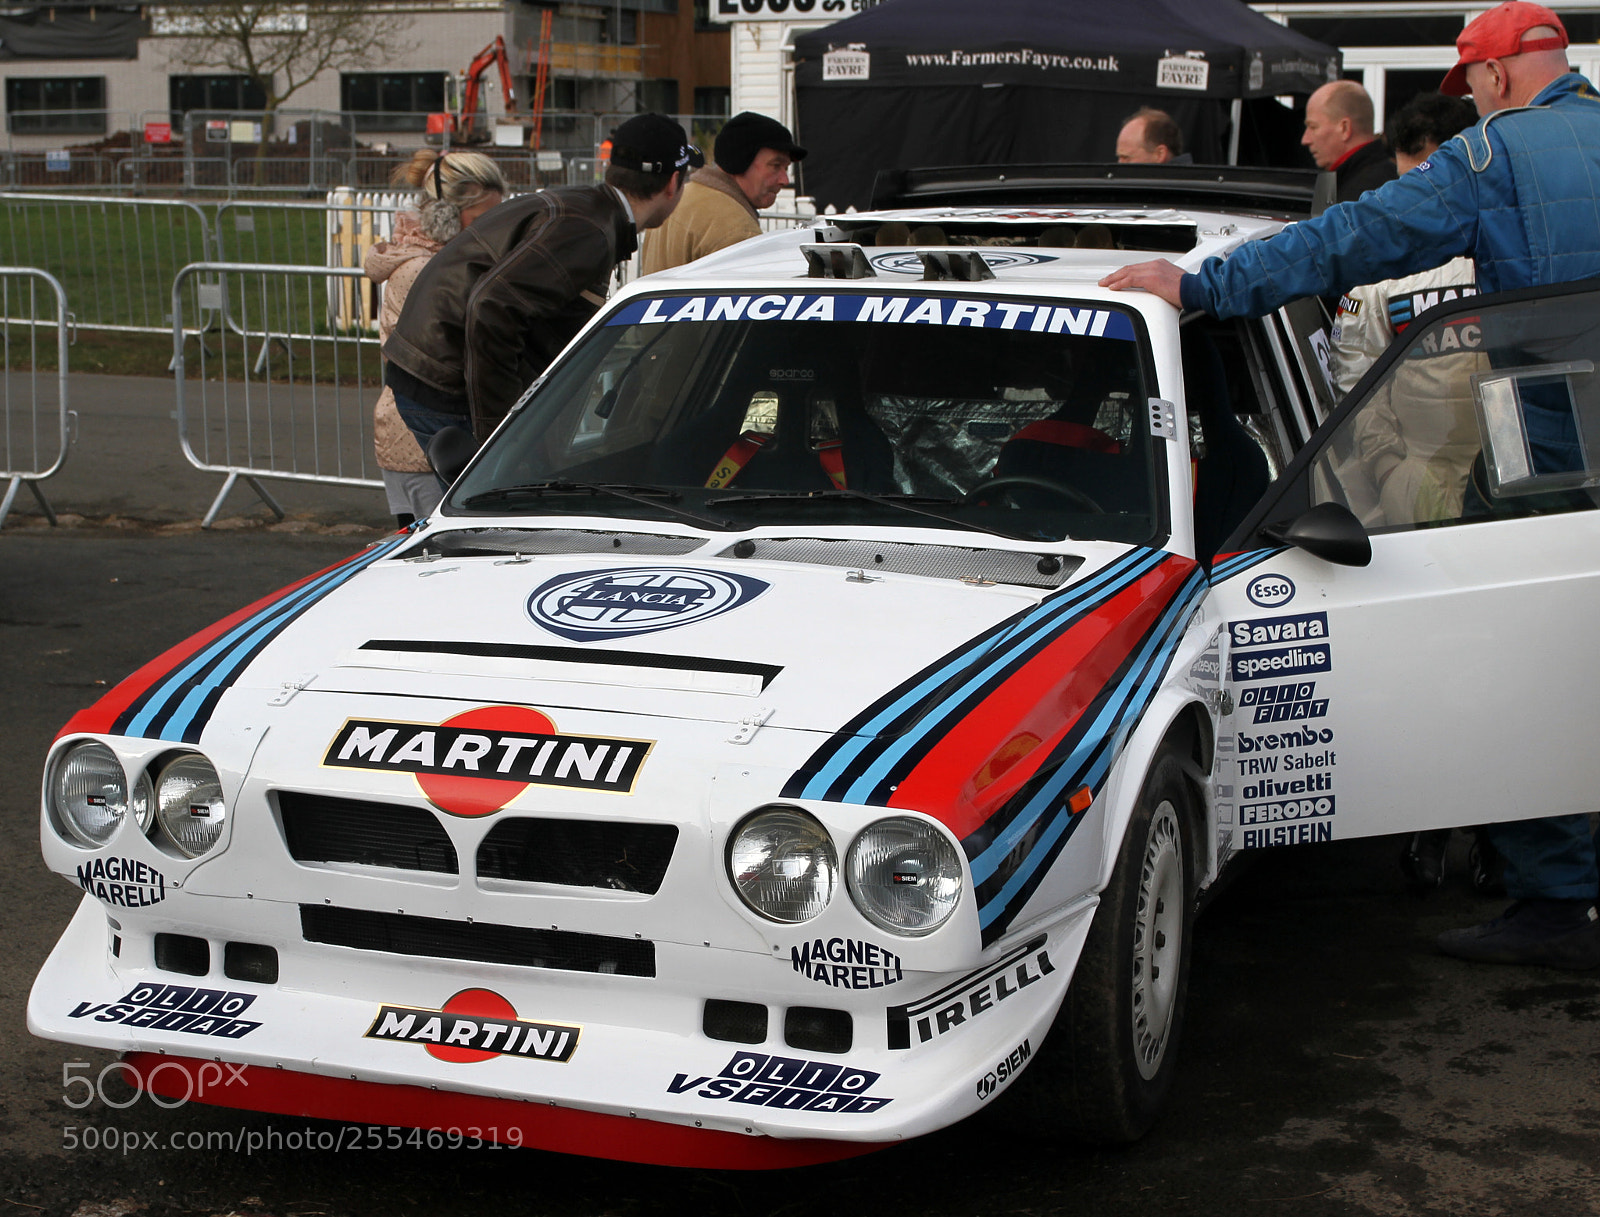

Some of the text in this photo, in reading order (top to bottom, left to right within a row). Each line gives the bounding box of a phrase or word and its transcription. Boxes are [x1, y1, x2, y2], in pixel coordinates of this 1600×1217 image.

[827, 65, 865, 76] FAYRE
[906, 49, 1119, 71] www.FarmersFayre.co.uk
[1162, 63, 1204, 72] FARMERS
[1161, 72, 1204, 85] FAYRE
[639, 295, 1111, 338] LANCIA MARTINI
[769, 367, 815, 380] sparco
[582, 590, 688, 606] LANCIA
[1254, 583, 1289, 598] Esso
[1233, 619, 1325, 645] Savara
[1236, 649, 1327, 678] speedline
[1243, 684, 1313, 705] OLIO
[1258, 702, 1326, 722] FIAT
[1237, 724, 1335, 754] brembo
[337, 726, 633, 784] MARTINI
[1237, 750, 1337, 776] TRW Sabelt
[1242, 772, 1332, 799] olivetti
[1242, 797, 1332, 824] FERODO
[1243, 821, 1332, 849] BILSTEIN
[77, 857, 165, 888] MAGNETI
[79, 878, 165, 907] MARELLI
[791, 937, 901, 968] MAGNETI
[793, 960, 902, 990] MARELLI
[126, 986, 249, 1015] OLIO
[886, 932, 1056, 1050] PIRELLI
[126, 1010, 255, 1036] FIAT
[375, 1011, 570, 1058] MARTINI
[727, 1055, 871, 1092] OLIO
[996, 1038, 1031, 1084] SIEM
[739, 1086, 885, 1113] FIAT
